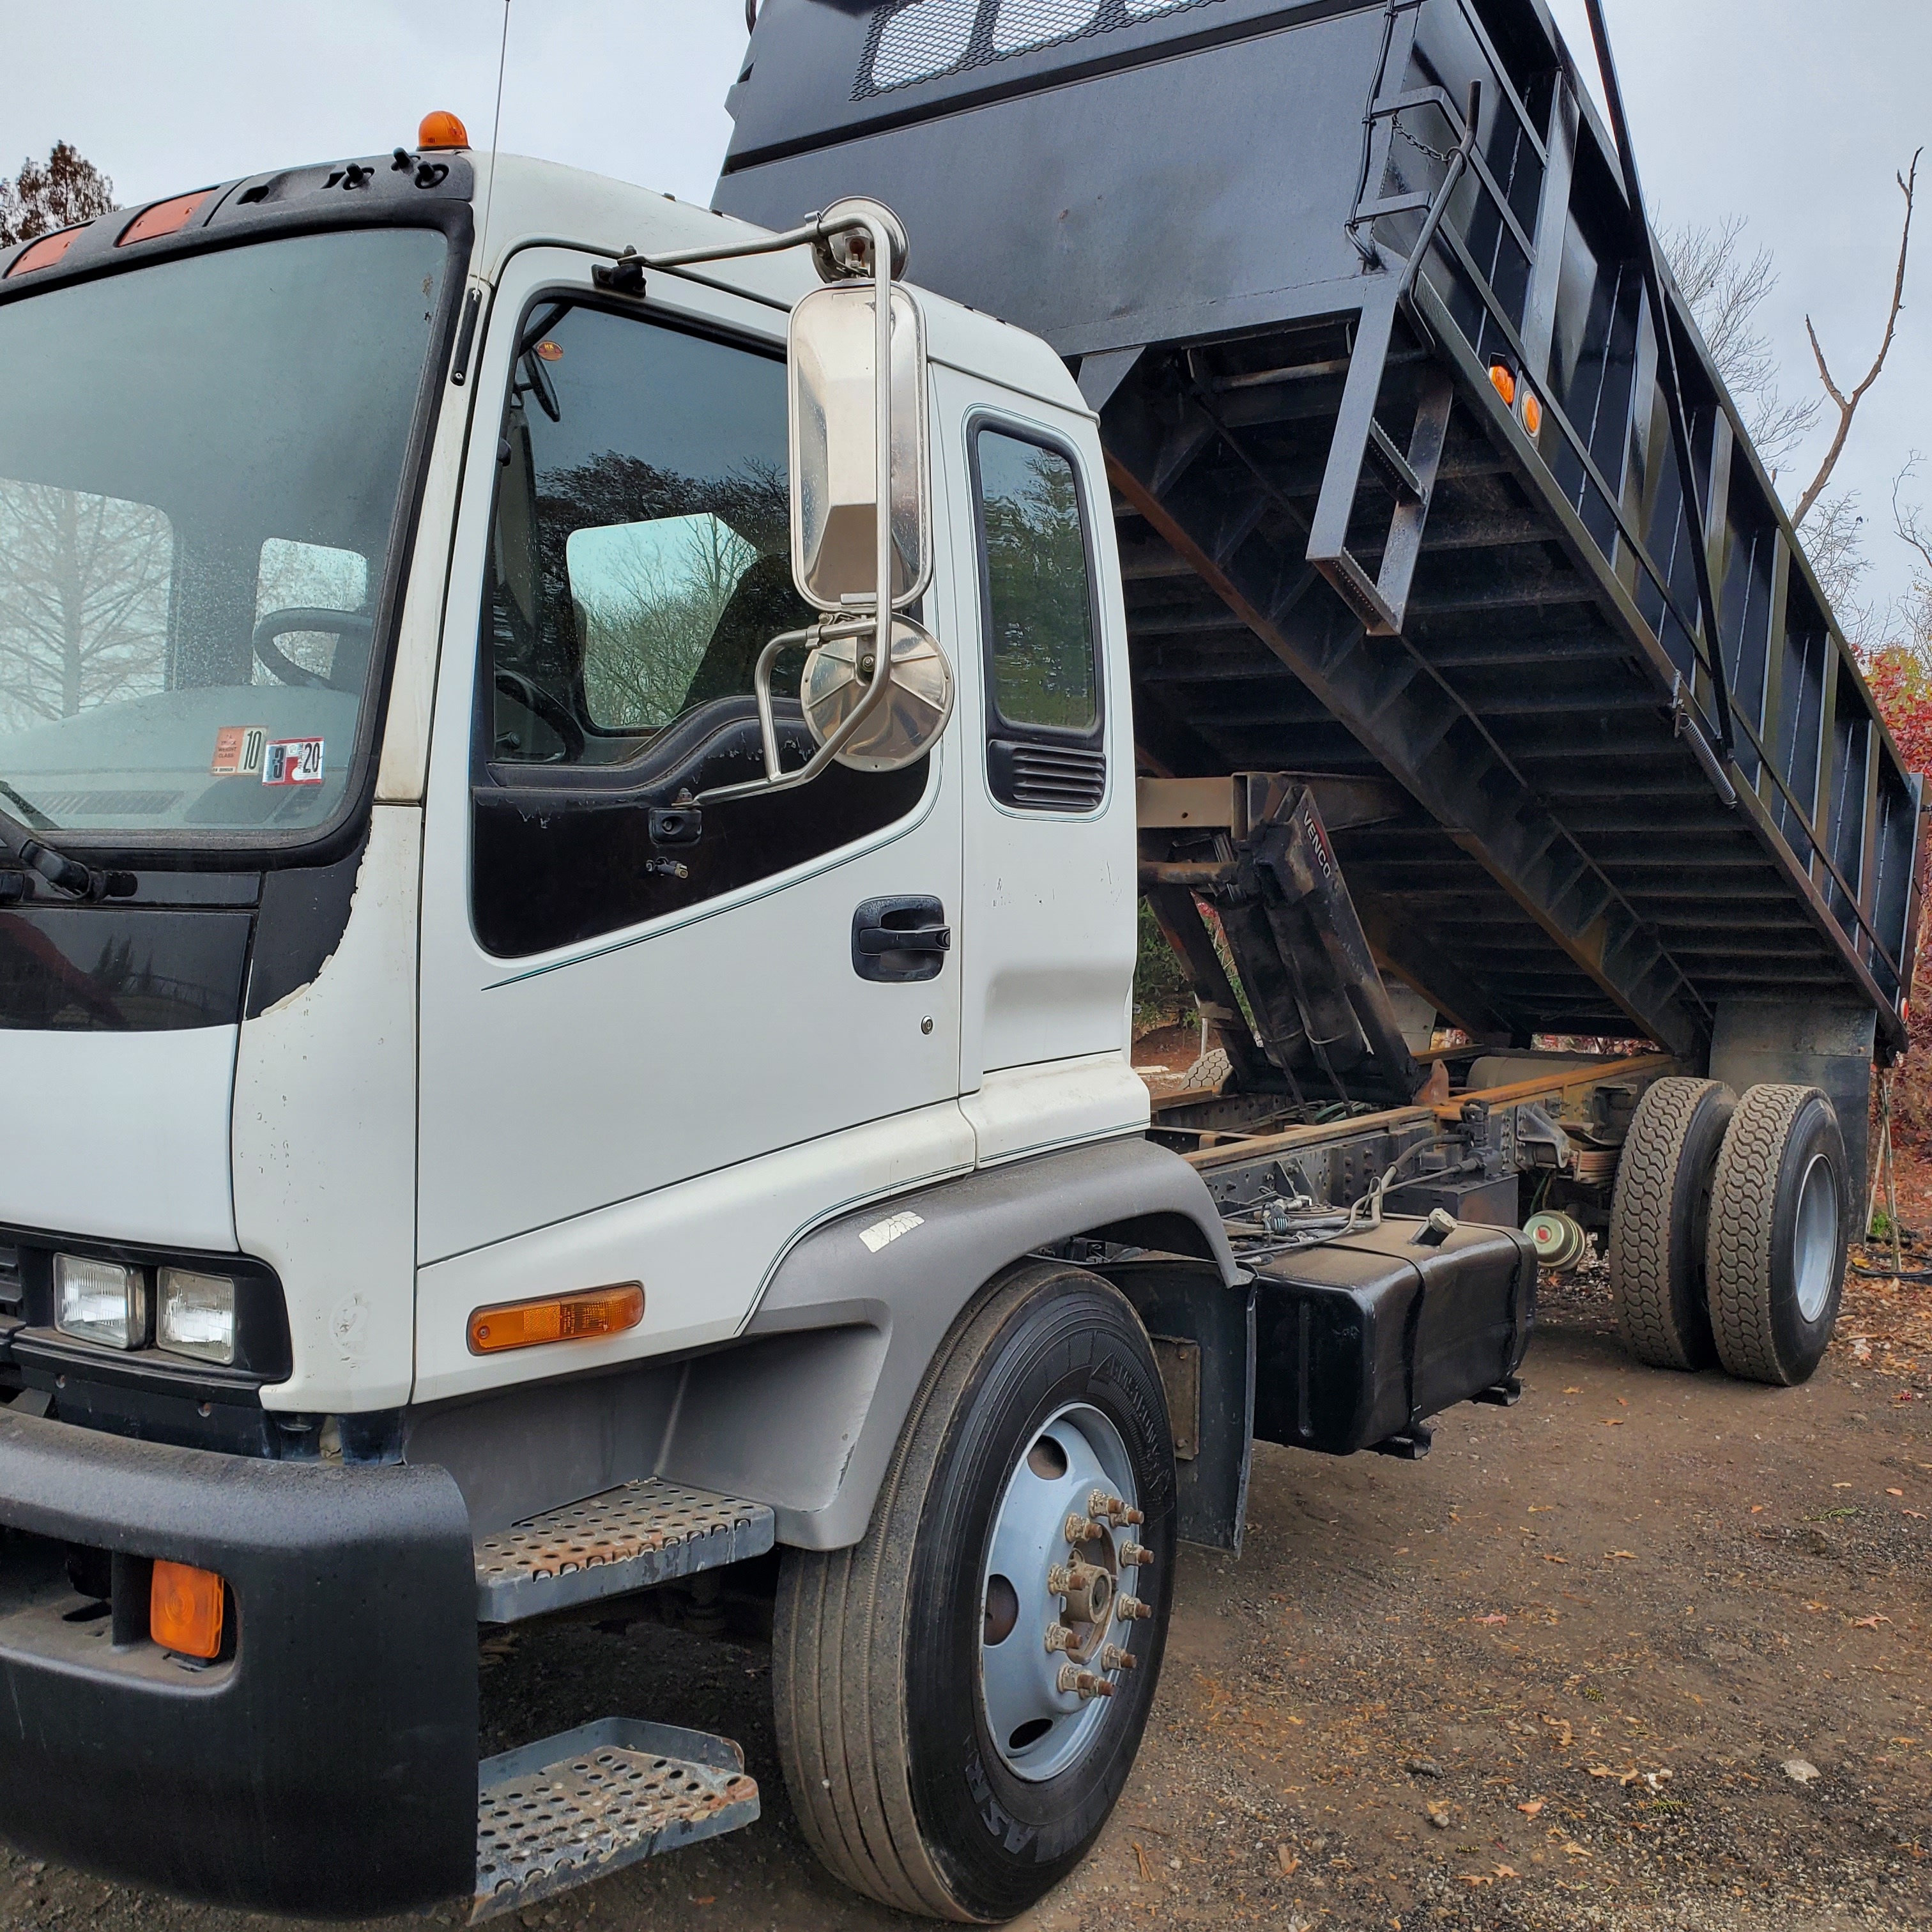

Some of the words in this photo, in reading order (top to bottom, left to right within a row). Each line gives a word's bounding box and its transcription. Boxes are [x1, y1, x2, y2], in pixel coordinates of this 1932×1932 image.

[243, 730, 262, 770] 10
[273, 747, 285, 779] 3
[303, 742, 321, 774] 20
[1303, 810, 1331, 878] VENCO
